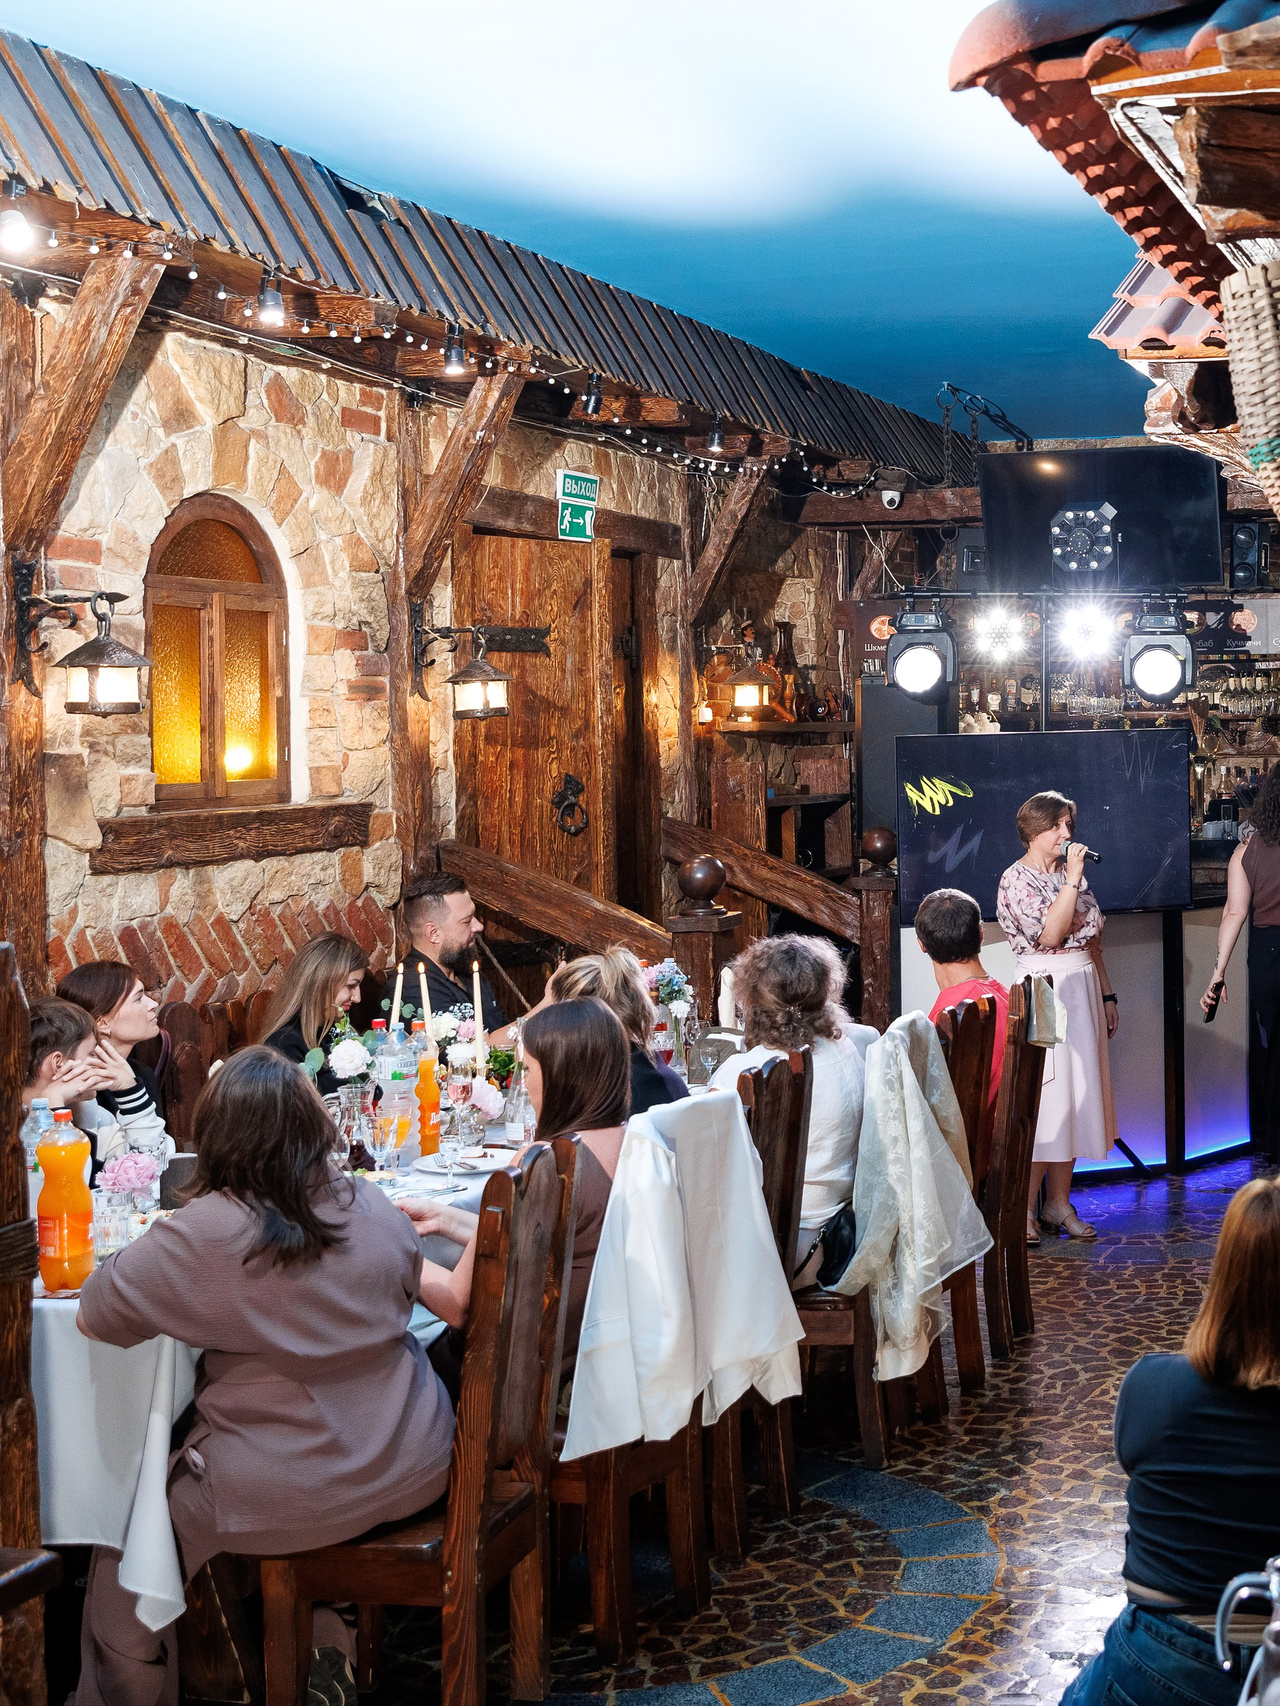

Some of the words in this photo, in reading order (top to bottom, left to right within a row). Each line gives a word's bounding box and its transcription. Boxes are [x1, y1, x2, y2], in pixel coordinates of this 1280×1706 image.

[565, 478, 597, 499] ВЫХОД
[864, 643, 887, 651] Шкме
[1227, 638, 1261, 648] Кучмачи
